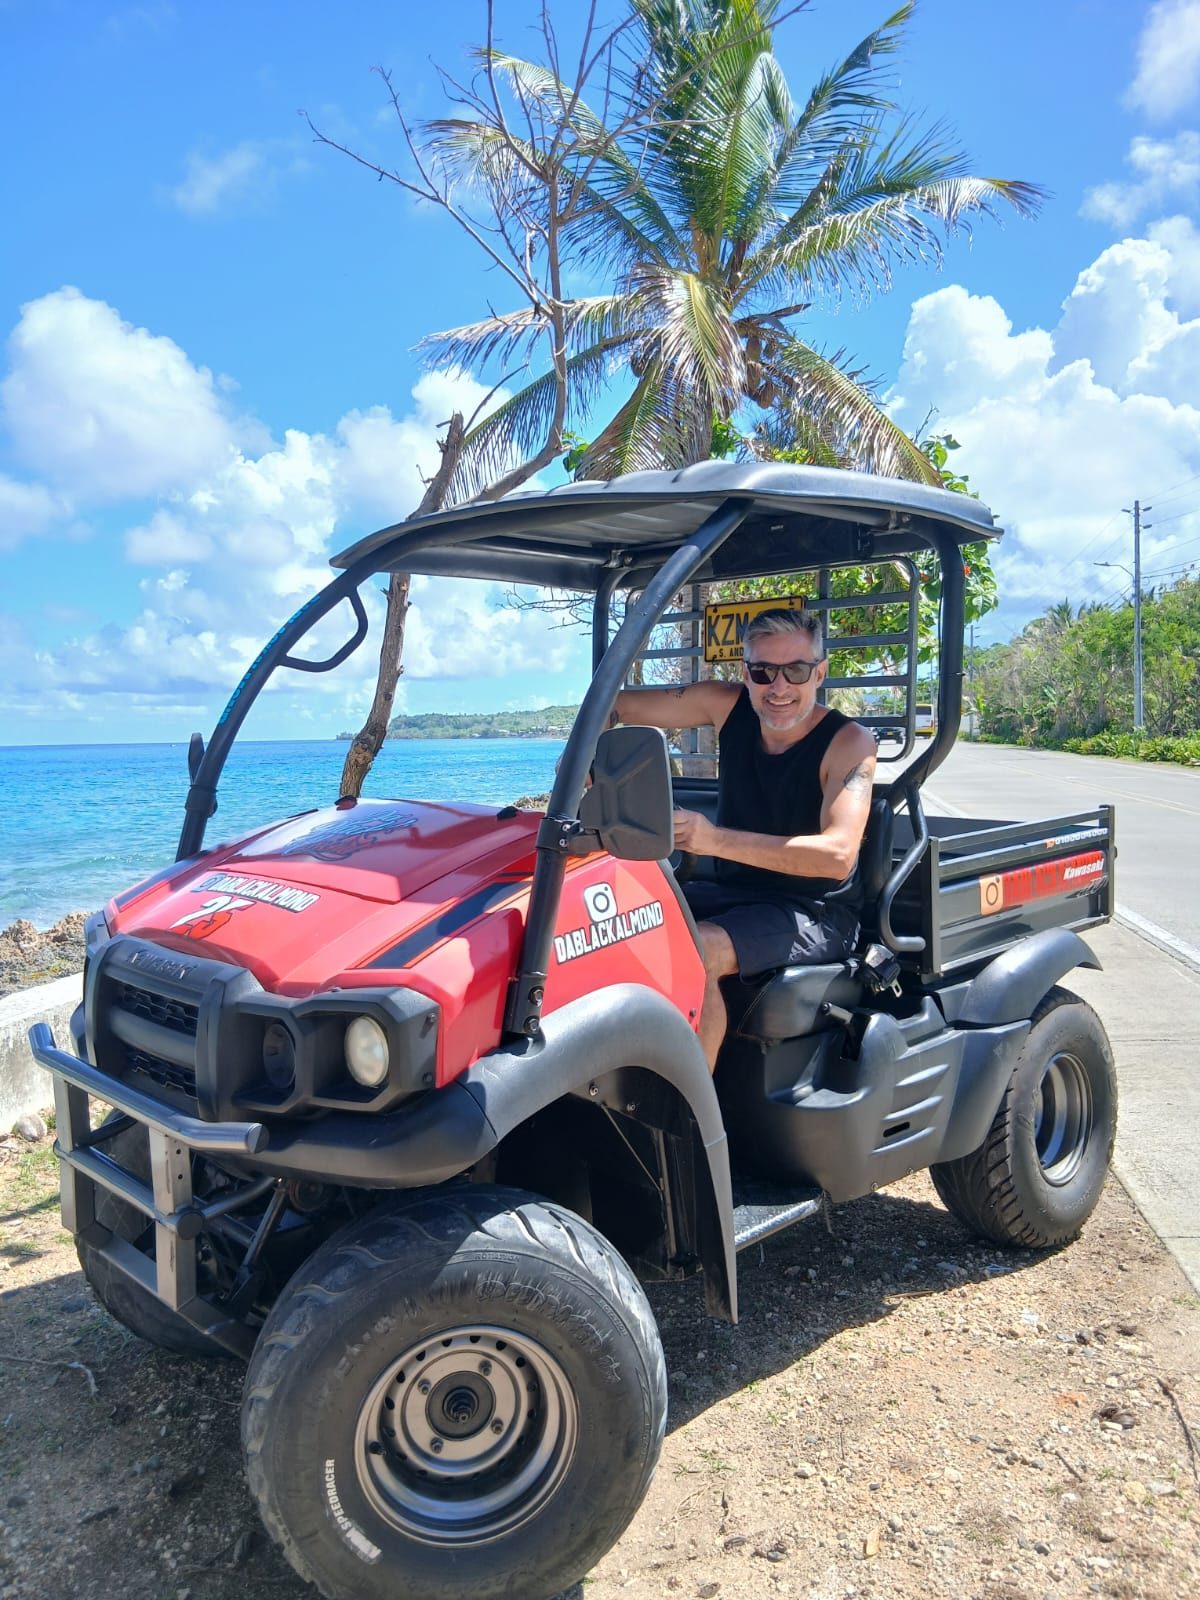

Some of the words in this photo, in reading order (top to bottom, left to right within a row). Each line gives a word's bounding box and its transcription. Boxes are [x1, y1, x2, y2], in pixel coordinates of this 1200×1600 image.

[1063, 858, 1105, 880] Kawasaki
[554, 900, 664, 965] DABLACKALMOND
[325, 1458, 353, 1532] SPEEDRACER
